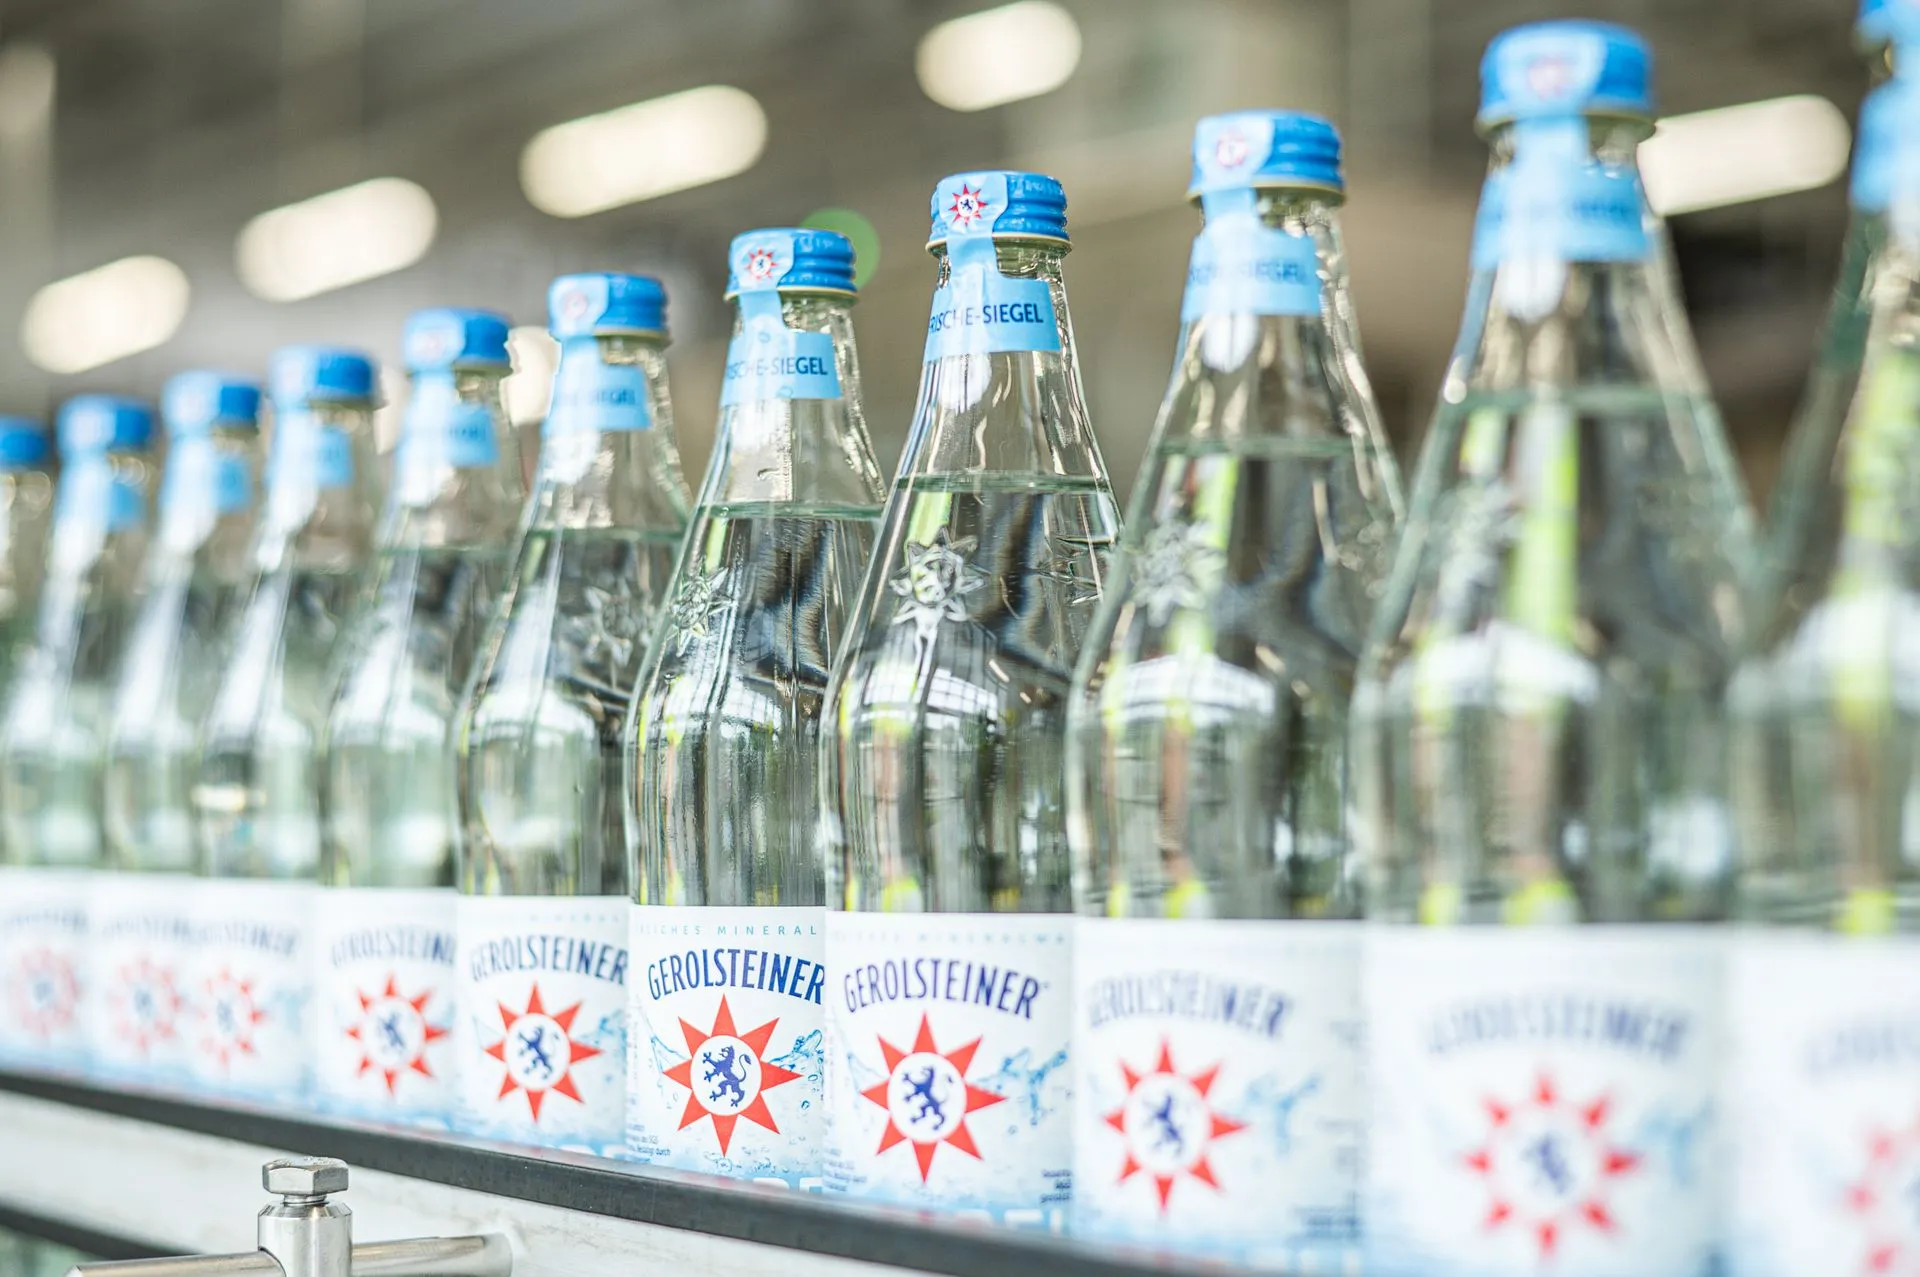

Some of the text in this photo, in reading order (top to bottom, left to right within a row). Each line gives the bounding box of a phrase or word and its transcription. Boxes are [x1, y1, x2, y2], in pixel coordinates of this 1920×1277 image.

[717, 925, 817, 936] MINERAL
[471, 934, 629, 985] GEROLSTEINER
[648, 948, 826, 1005] GEROLSTEINER
[843, 957, 1041, 1020] GEROLSTEINER
